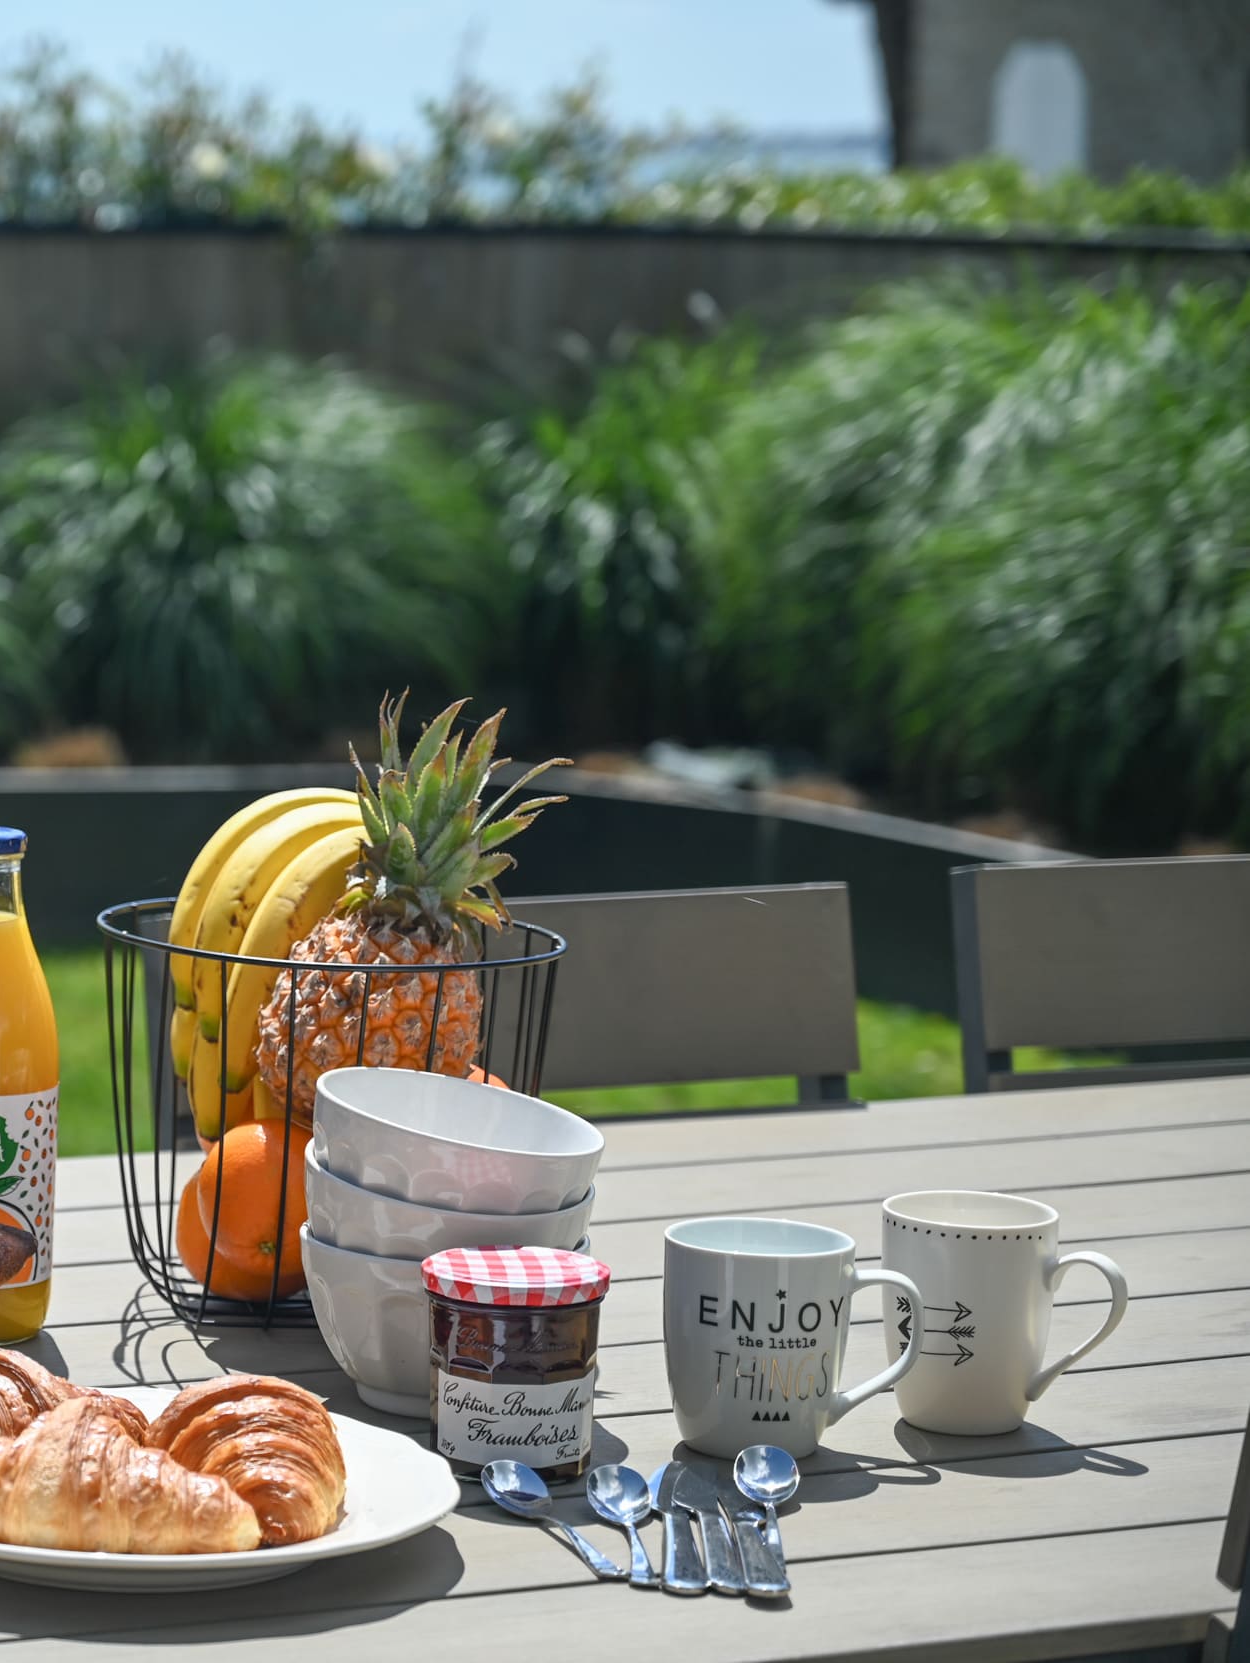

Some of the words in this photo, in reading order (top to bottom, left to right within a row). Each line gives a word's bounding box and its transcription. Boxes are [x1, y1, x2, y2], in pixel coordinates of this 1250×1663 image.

[736, 1335, 764, 1348] the
[768, 1337, 817, 1349] little
[714, 1350, 831, 1403] THINGS
[443, 1381, 500, 1416] Confiture
[501, 1391, 554, 1417] Bonne
[467, 1418, 580, 1447] Framboises
